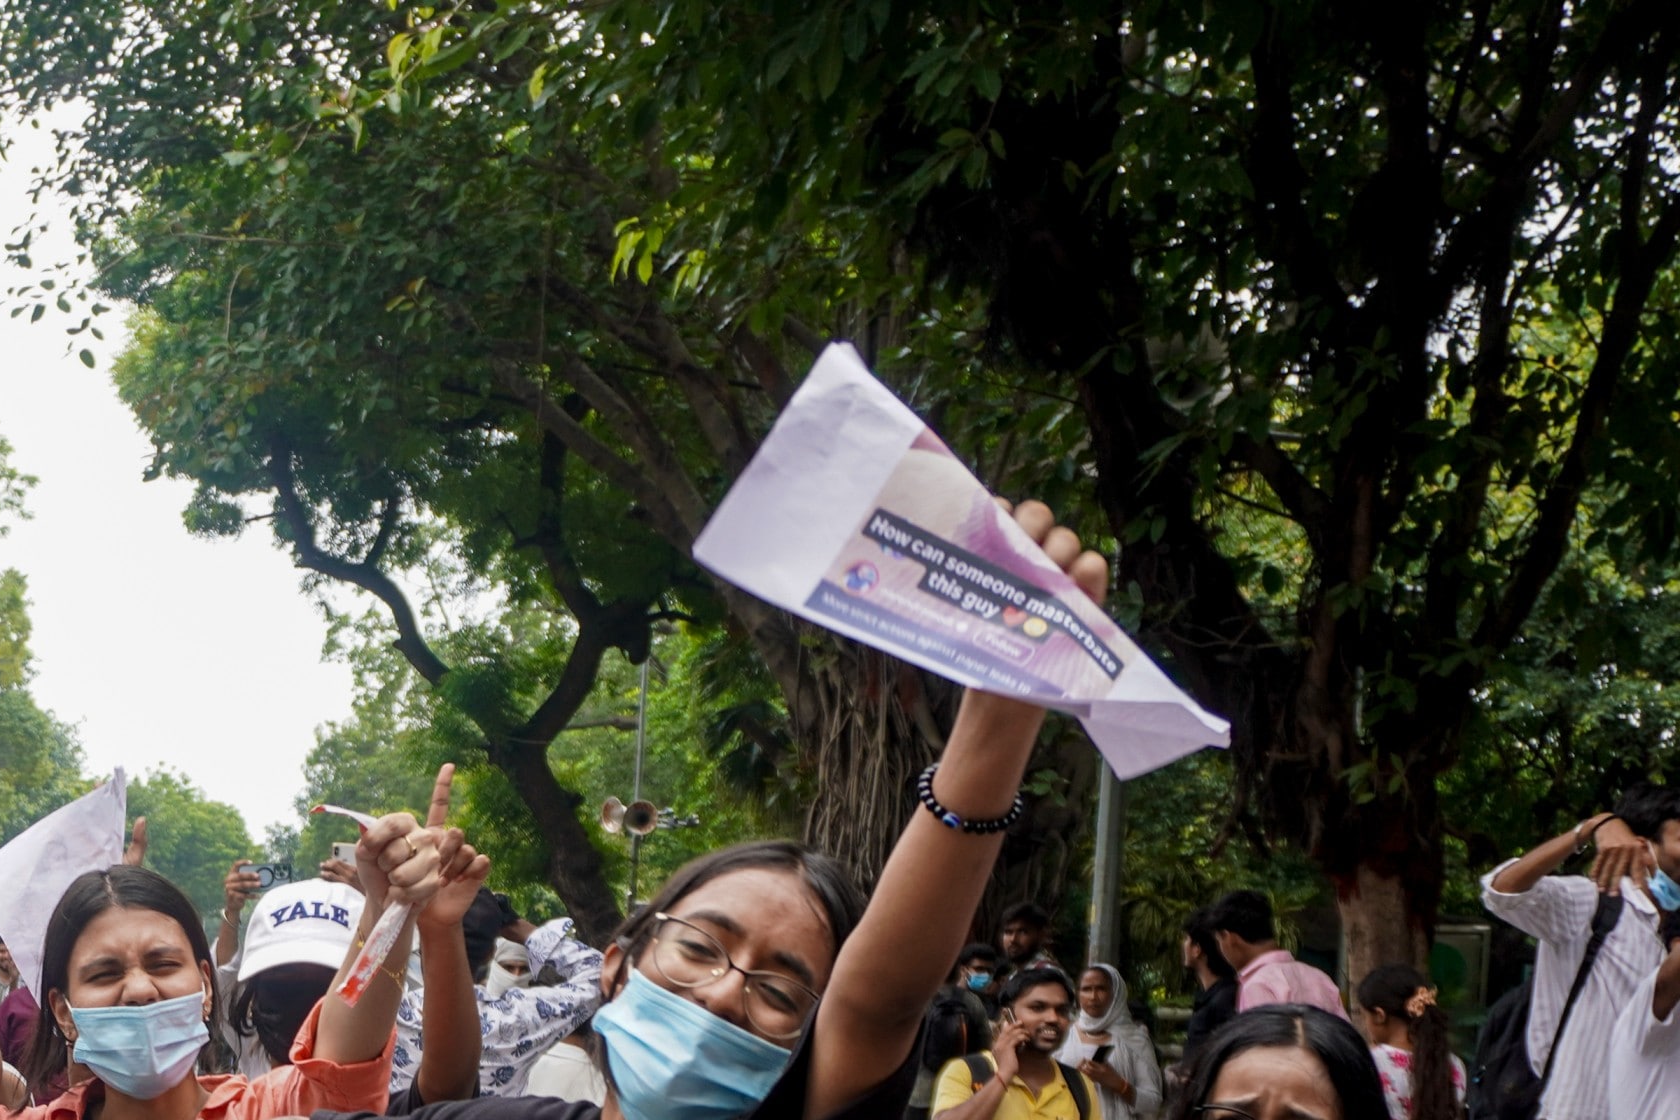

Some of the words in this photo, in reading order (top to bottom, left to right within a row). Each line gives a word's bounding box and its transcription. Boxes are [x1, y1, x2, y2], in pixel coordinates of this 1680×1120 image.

[870, 515, 912, 547] How
[911, 539, 945, 565] can
[945, 556, 1027, 607] someone
[1025, 597, 1118, 673] masterbate
[928, 571, 963, 600] this
[961, 592, 1000, 619] guy
[271, 901, 349, 928] YALE
